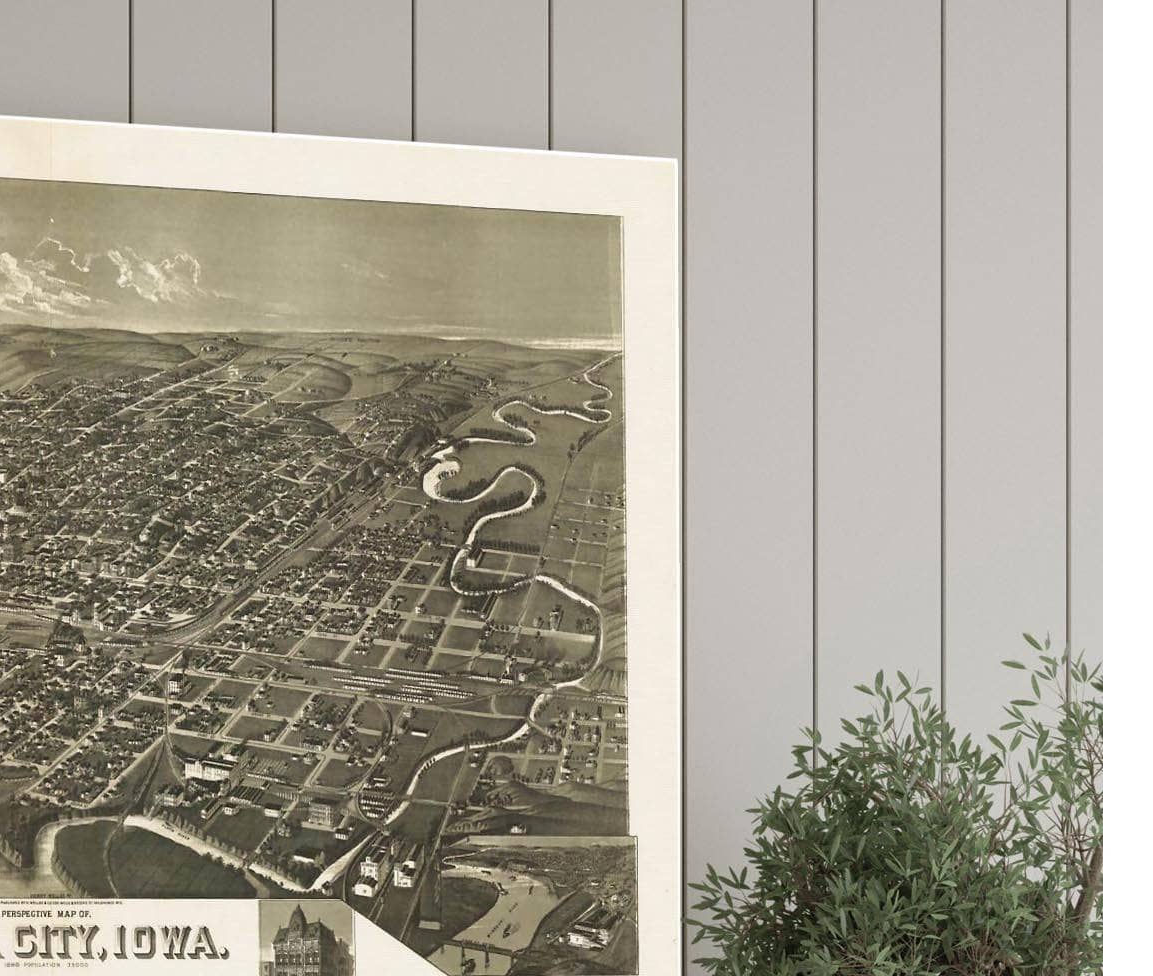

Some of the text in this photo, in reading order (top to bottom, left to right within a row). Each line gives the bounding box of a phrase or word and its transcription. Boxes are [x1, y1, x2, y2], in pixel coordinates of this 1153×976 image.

[1, 910, 53, 918] PERSPECTIVE
[57, 910, 77, 918] MAP
[13, 924, 108, 962] CITY,
